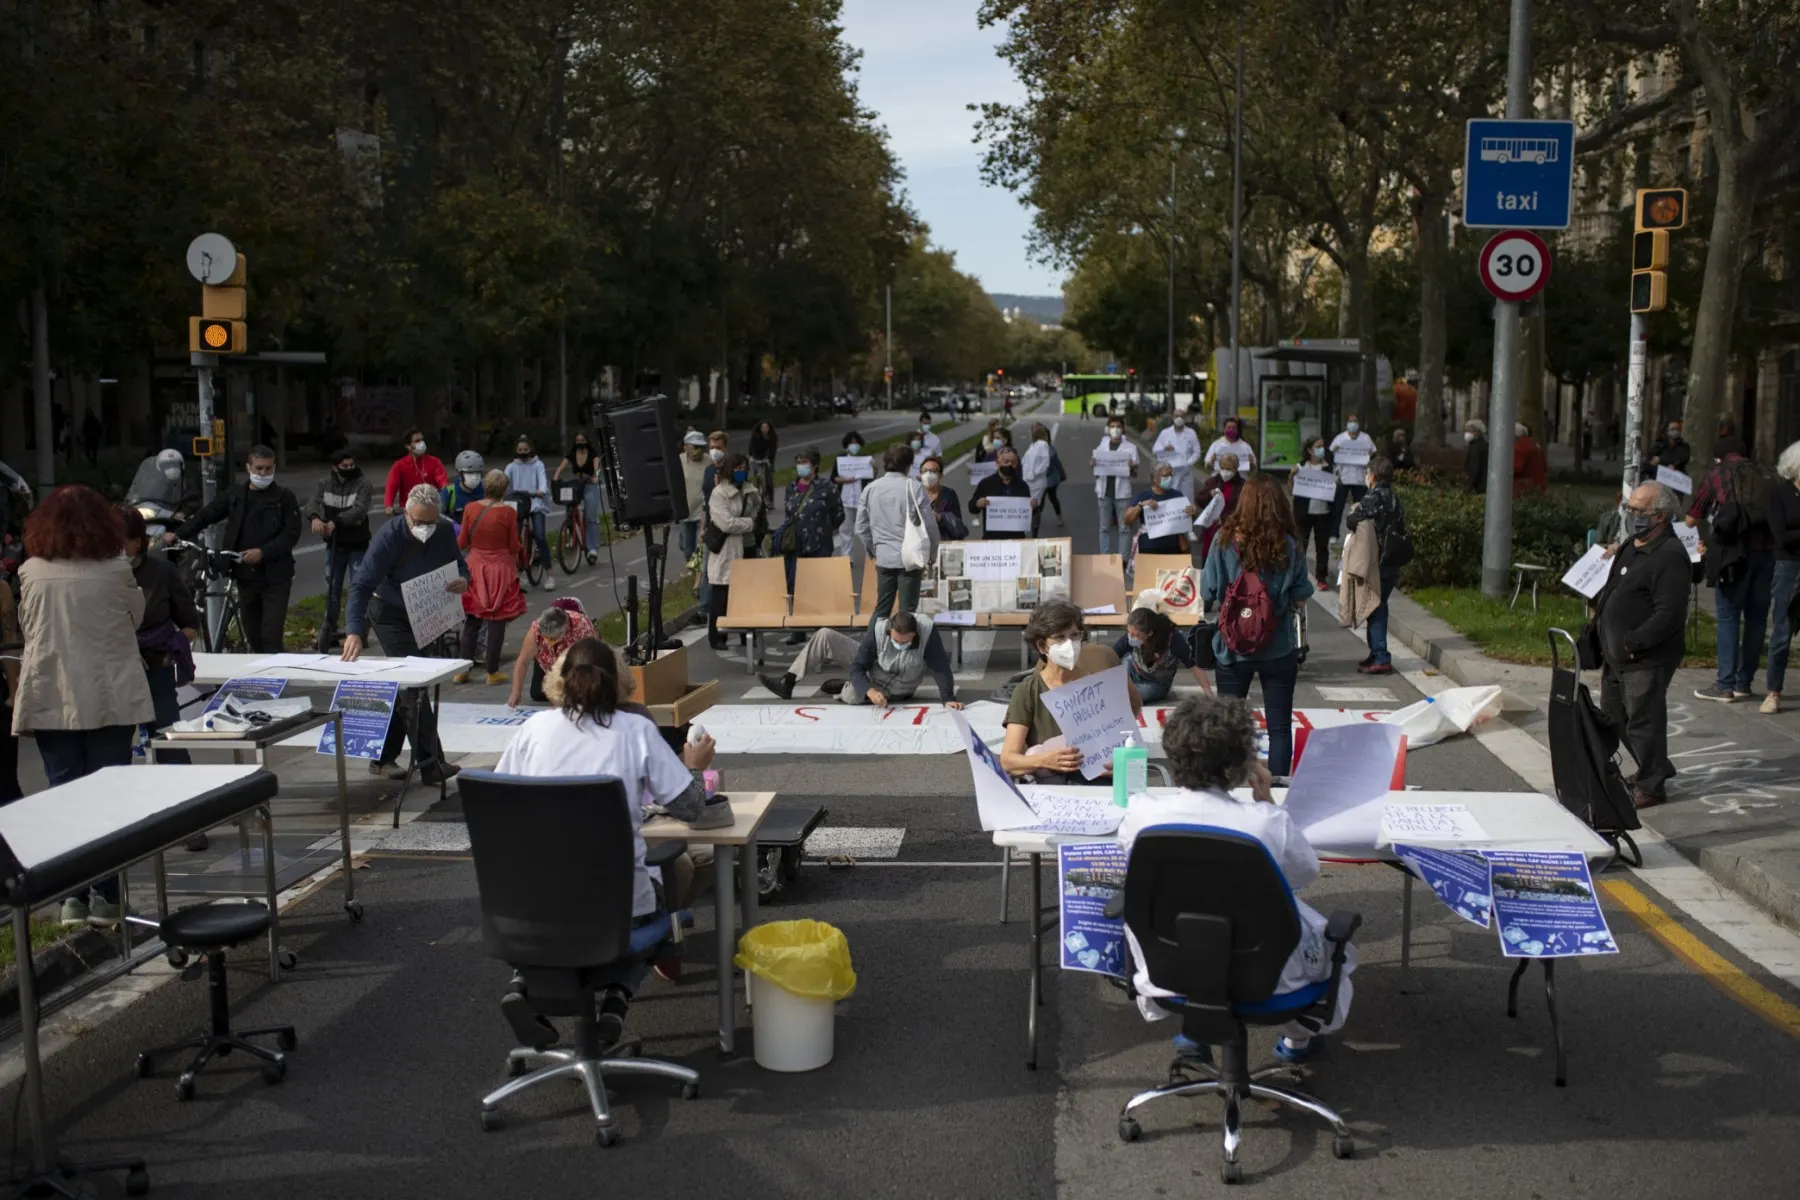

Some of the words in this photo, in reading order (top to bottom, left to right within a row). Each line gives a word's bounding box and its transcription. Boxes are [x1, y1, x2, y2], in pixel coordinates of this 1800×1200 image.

[1496, 191, 1538, 210] taxi
[1496, 254, 1535, 276] 30
[406, 570, 447, 591] SANITAT
